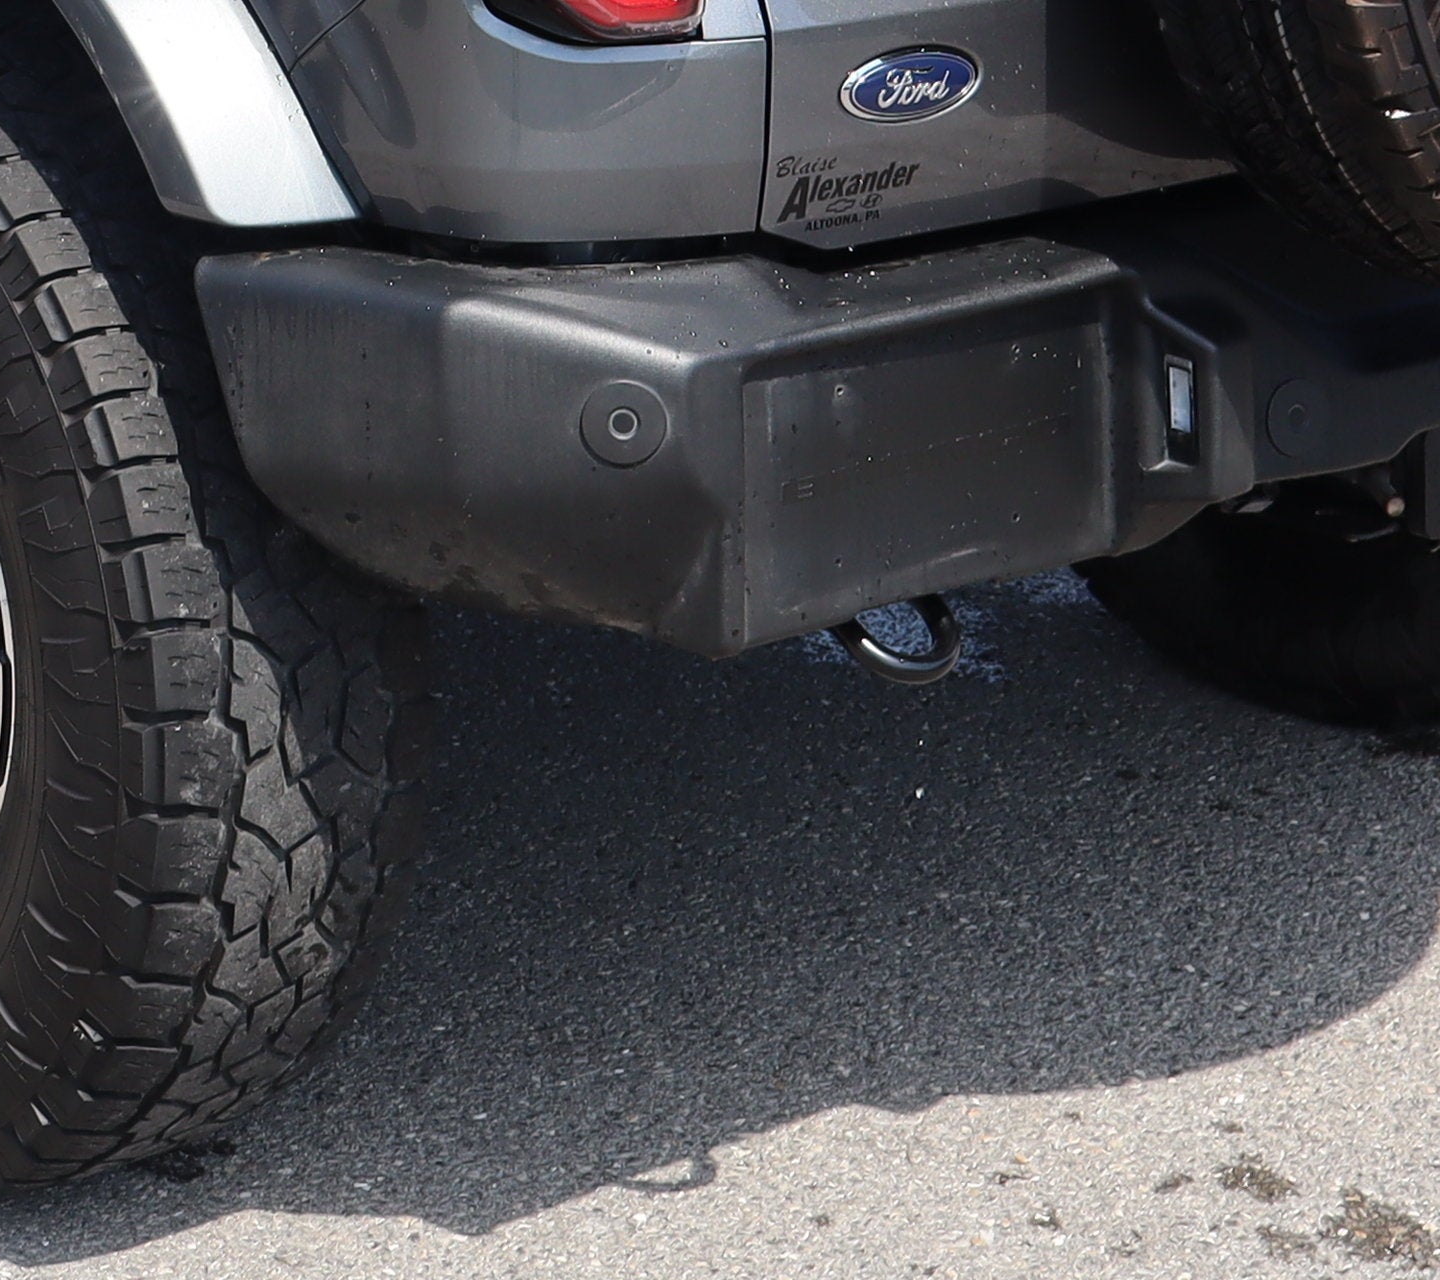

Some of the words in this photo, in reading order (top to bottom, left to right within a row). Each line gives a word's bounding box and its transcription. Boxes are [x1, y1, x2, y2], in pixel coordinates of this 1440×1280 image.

[878, 64, 950, 108] Ford
[776, 155, 838, 178] Blaise
[777, 161, 921, 223] Alexander
[865, 209, 881, 222] PA
